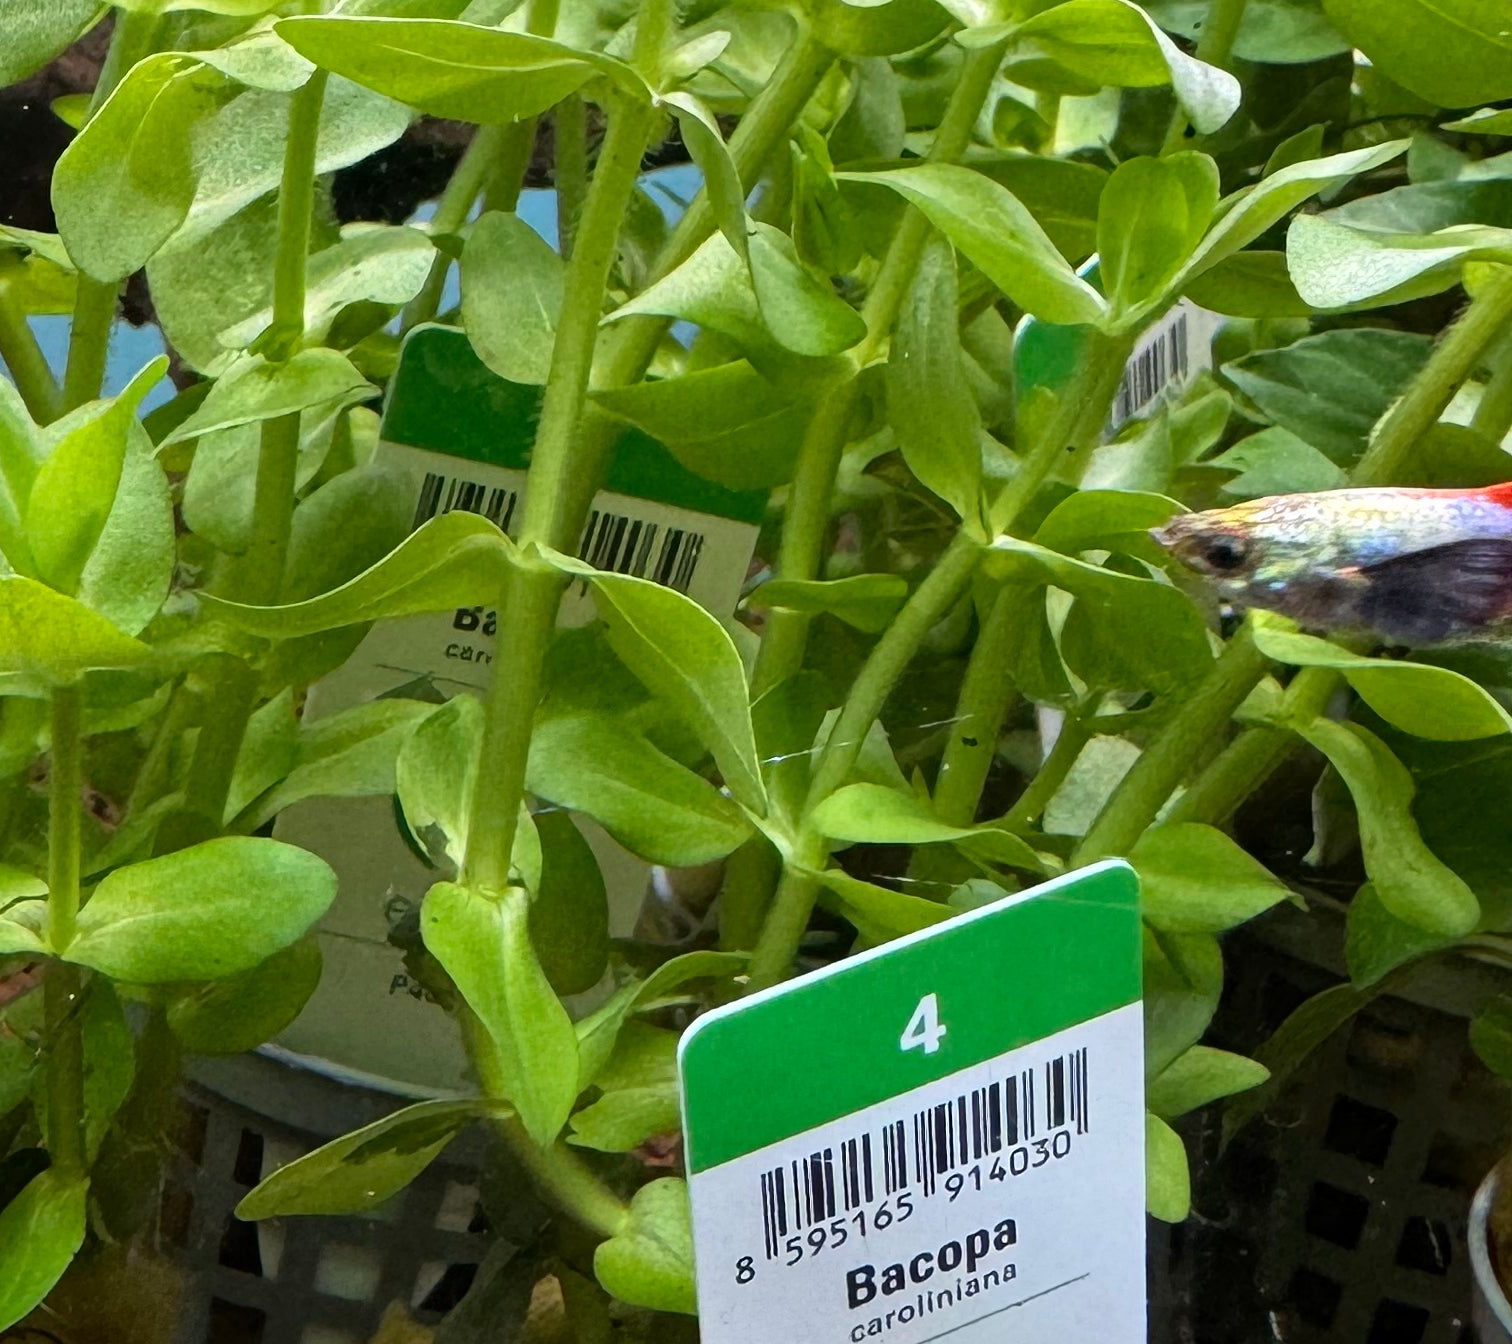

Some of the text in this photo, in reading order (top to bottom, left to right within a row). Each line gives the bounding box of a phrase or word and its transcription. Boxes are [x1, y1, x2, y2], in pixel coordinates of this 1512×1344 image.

[898, 992, 947, 1054] 4
[735, 1129, 1072, 1285] 8 595165 914030
[845, 1217, 1019, 1310] Bacopa
[848, 1262, 1019, 1344] caroliniana
